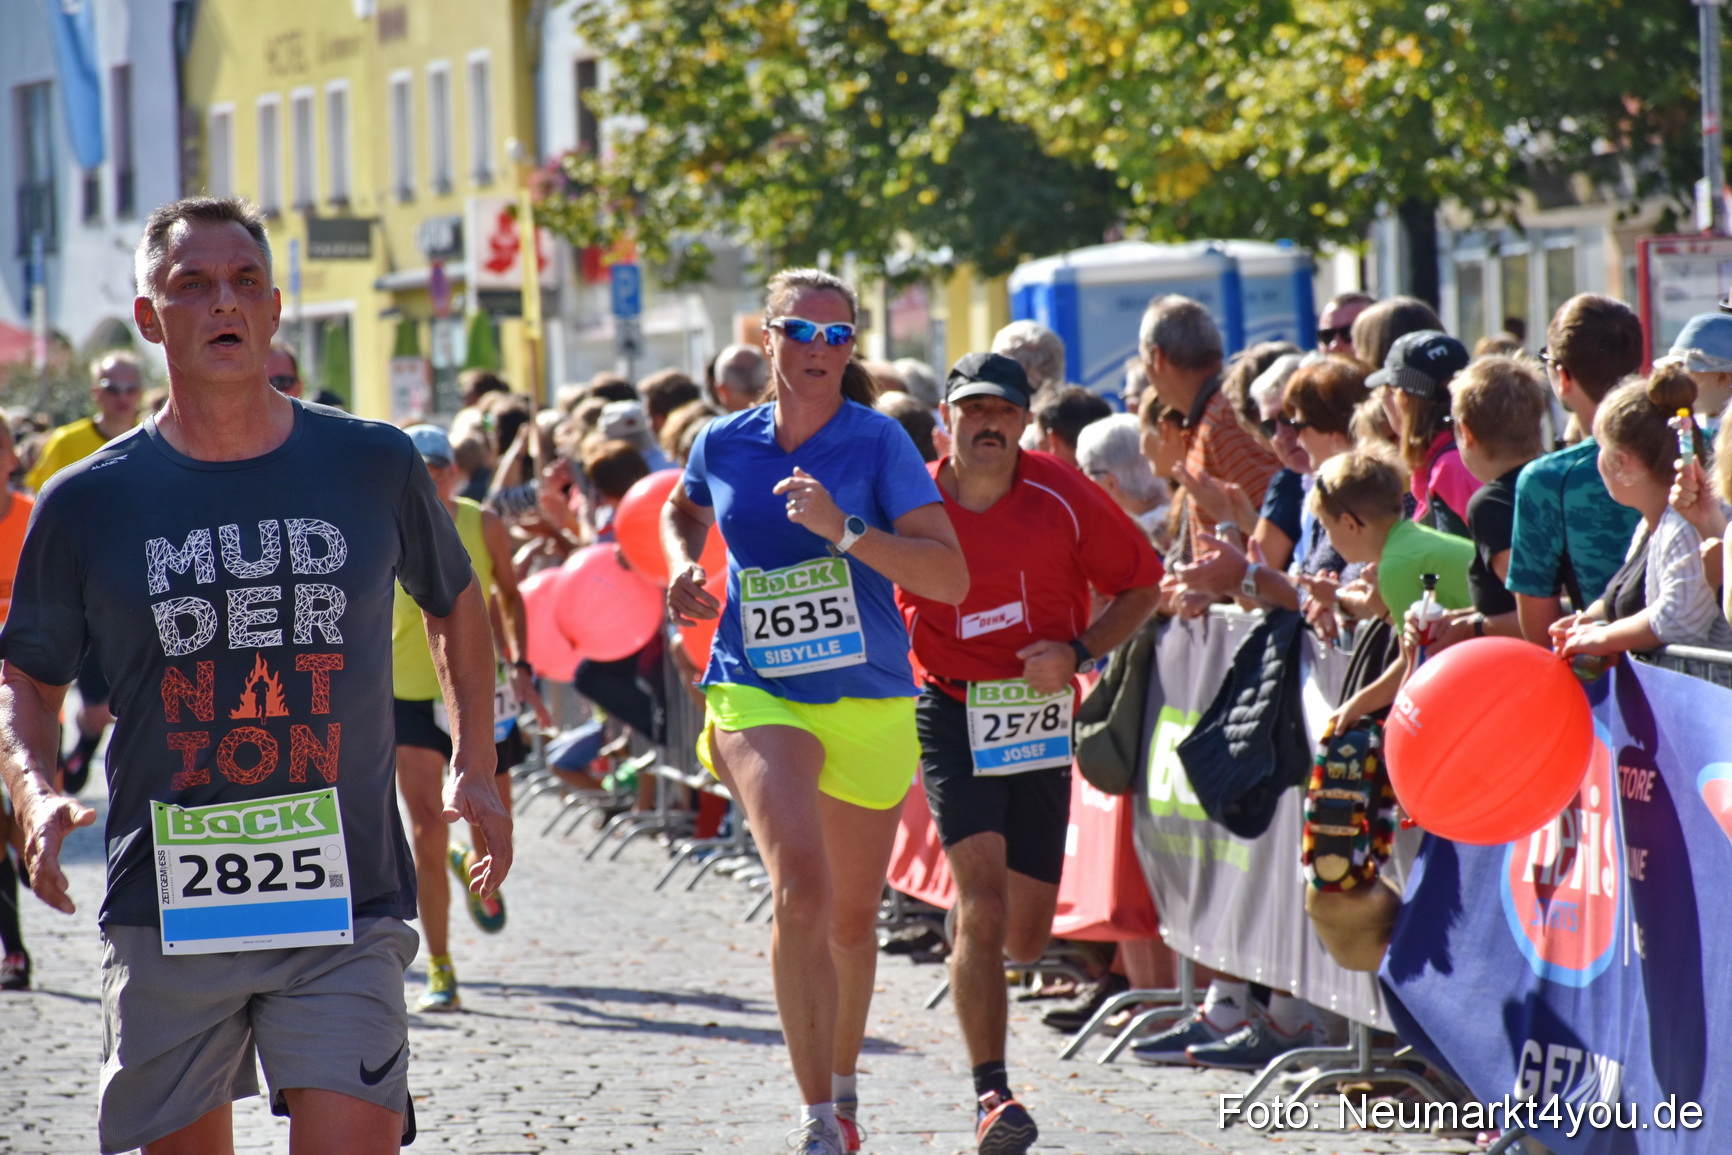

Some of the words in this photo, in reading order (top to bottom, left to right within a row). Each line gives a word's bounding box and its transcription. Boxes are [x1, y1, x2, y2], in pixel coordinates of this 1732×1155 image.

[145, 517, 348, 596] MUD
[749, 562, 838, 598] BOCK
[150, 583, 348, 657] DER
[752, 596, 844, 640] 2635
[979, 613, 1006, 628] DEHN
[764, 639, 842, 665] SIBYLLE
[982, 703, 1060, 743] 2578
[166, 722, 342, 791] ION
[1001, 743, 1047, 764] JOSEF
[168, 799, 322, 840] BOCK
[179, 847, 326, 898] 2825
